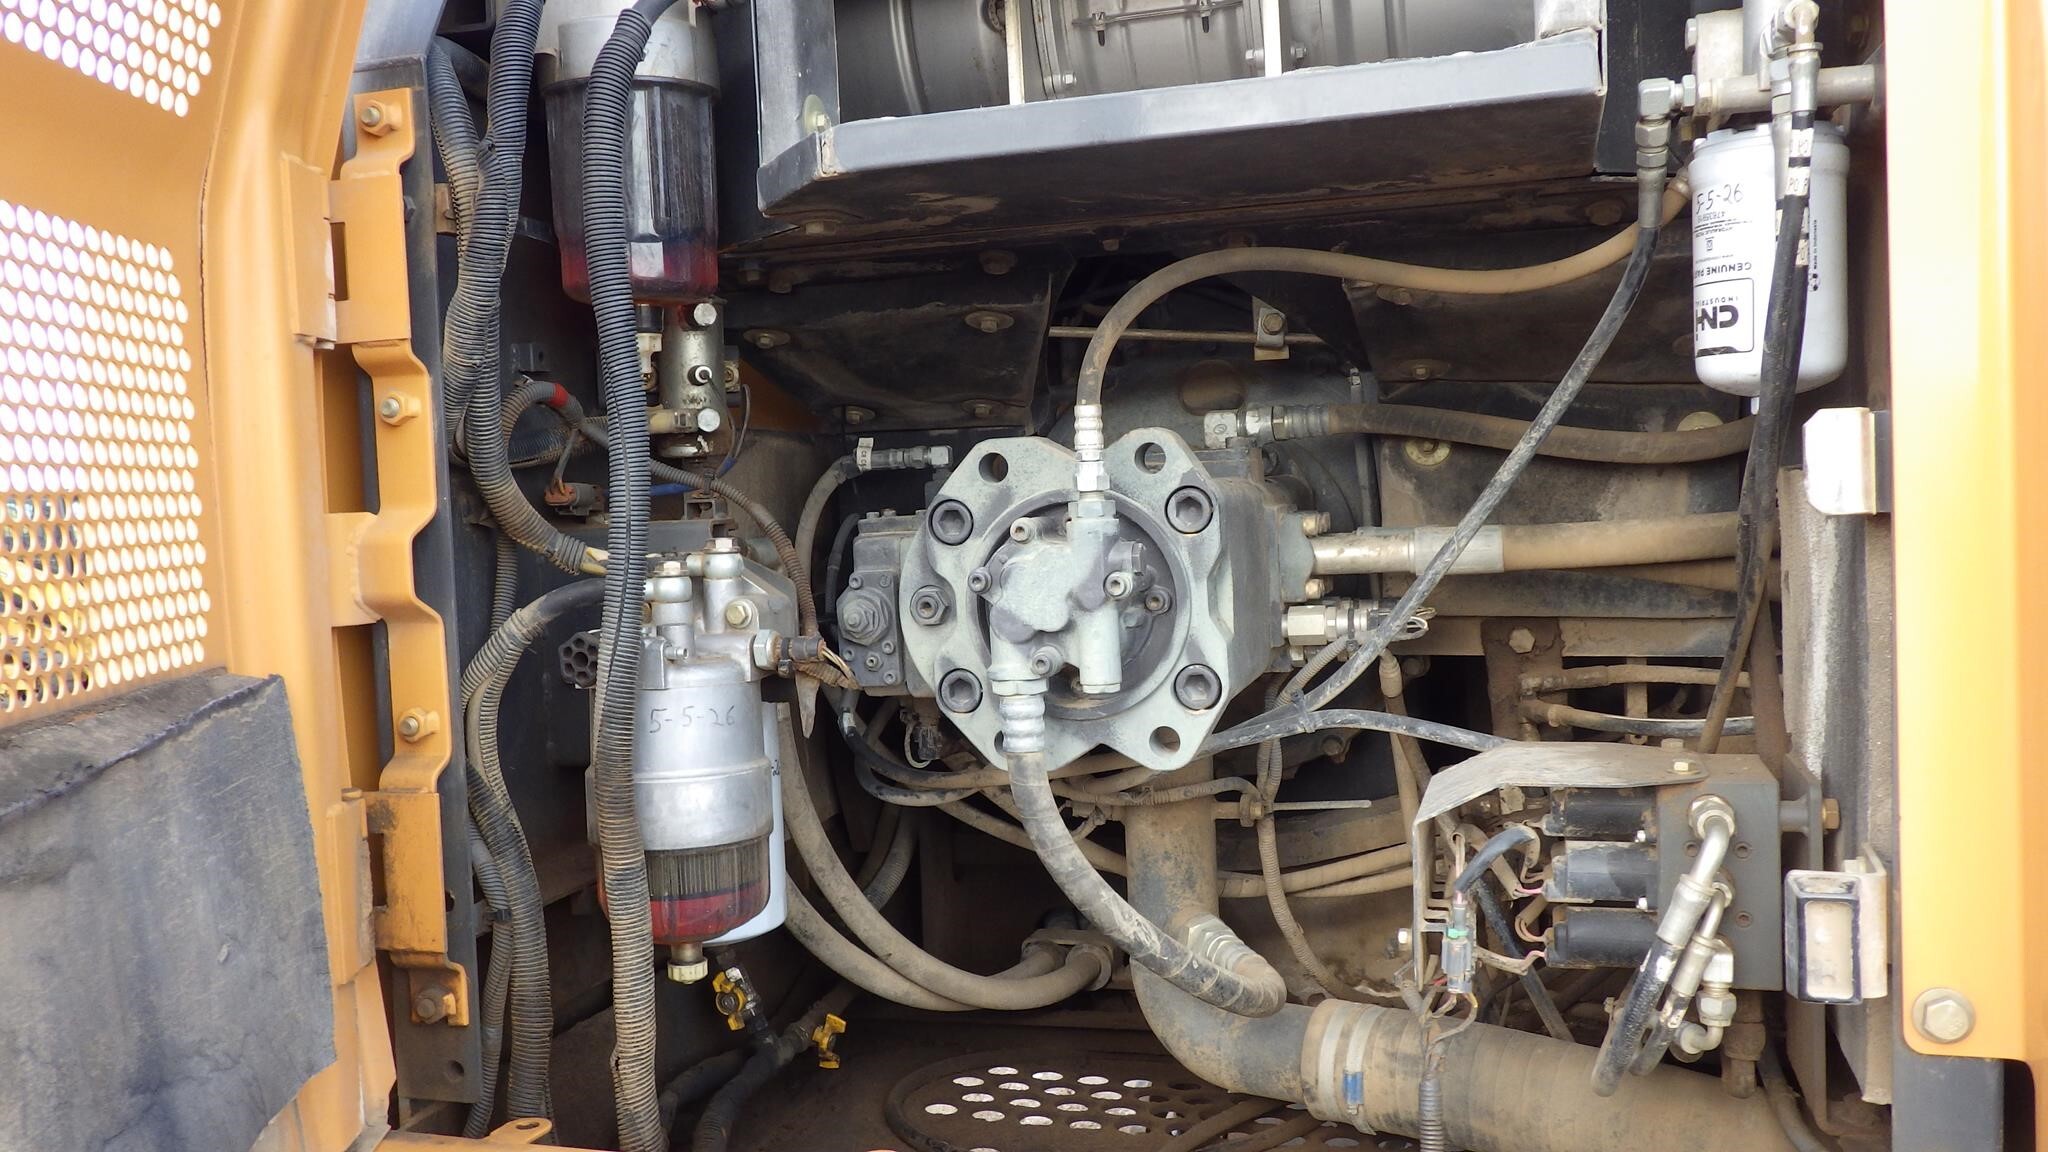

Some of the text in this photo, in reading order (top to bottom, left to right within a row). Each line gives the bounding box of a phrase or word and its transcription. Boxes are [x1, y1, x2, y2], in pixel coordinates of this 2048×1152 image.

[1706, 262, 1752, 276] GENUINE
[1696, 296, 1739, 307] INDUSTRIA
[1695, 304, 1739, 332] CNH
[649, 704, 736, 734] 5-5-26
